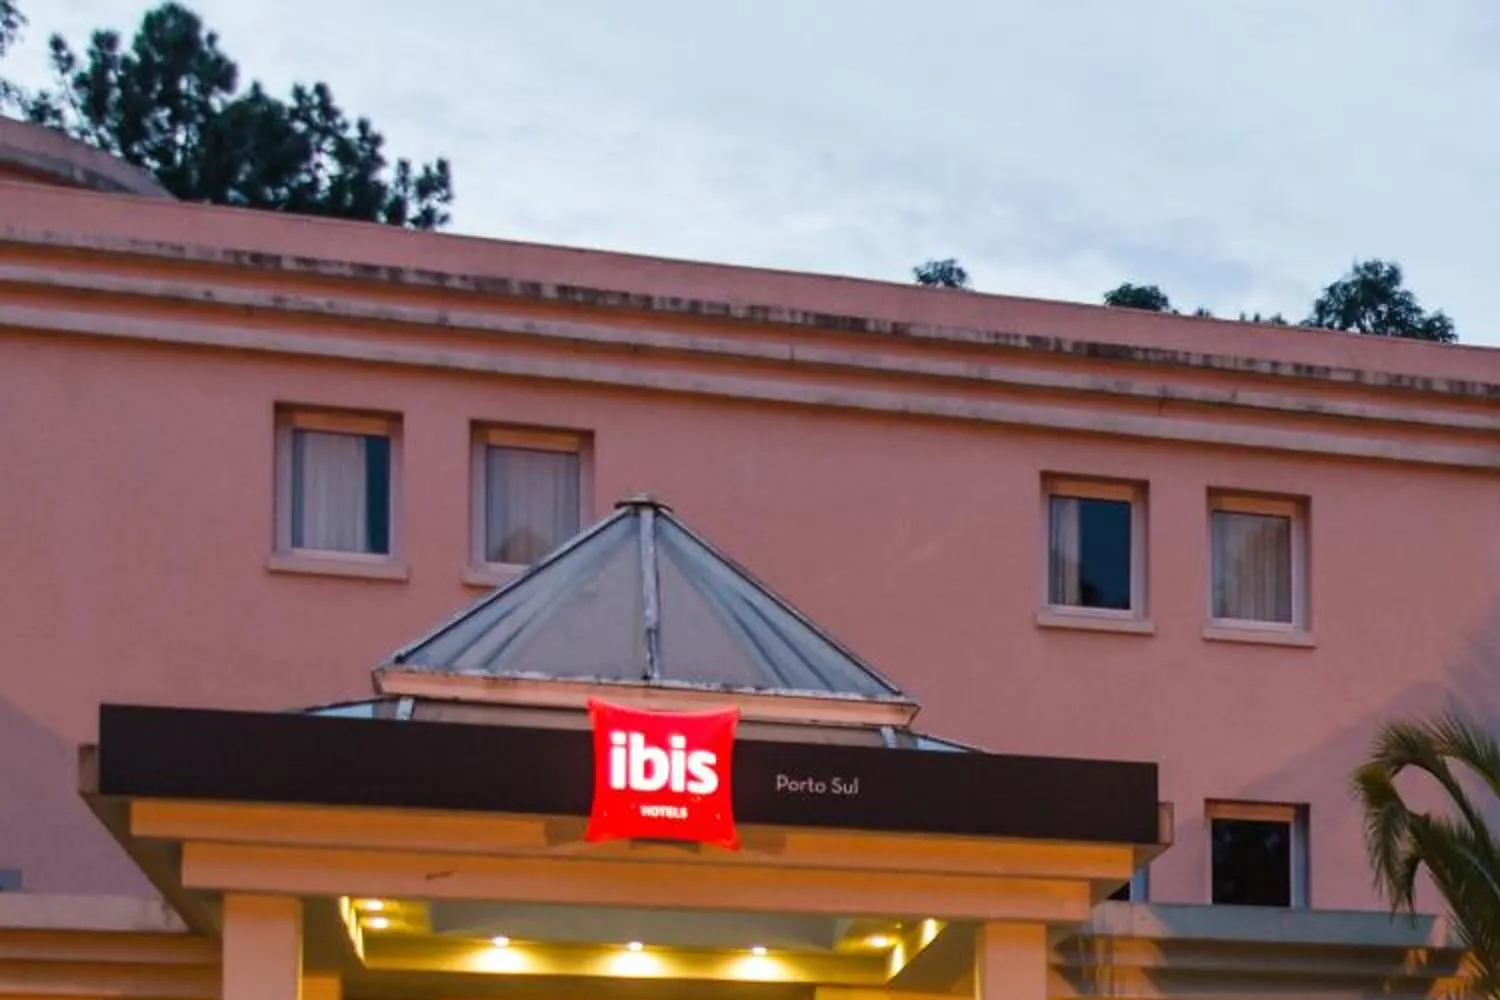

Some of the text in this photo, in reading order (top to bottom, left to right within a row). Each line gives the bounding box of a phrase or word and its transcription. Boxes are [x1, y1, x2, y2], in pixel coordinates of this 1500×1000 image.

[608, 730, 720, 794] ibis
[776, 774, 860, 795] Porto Sul
[640, 805, 689, 819] HOTELS
